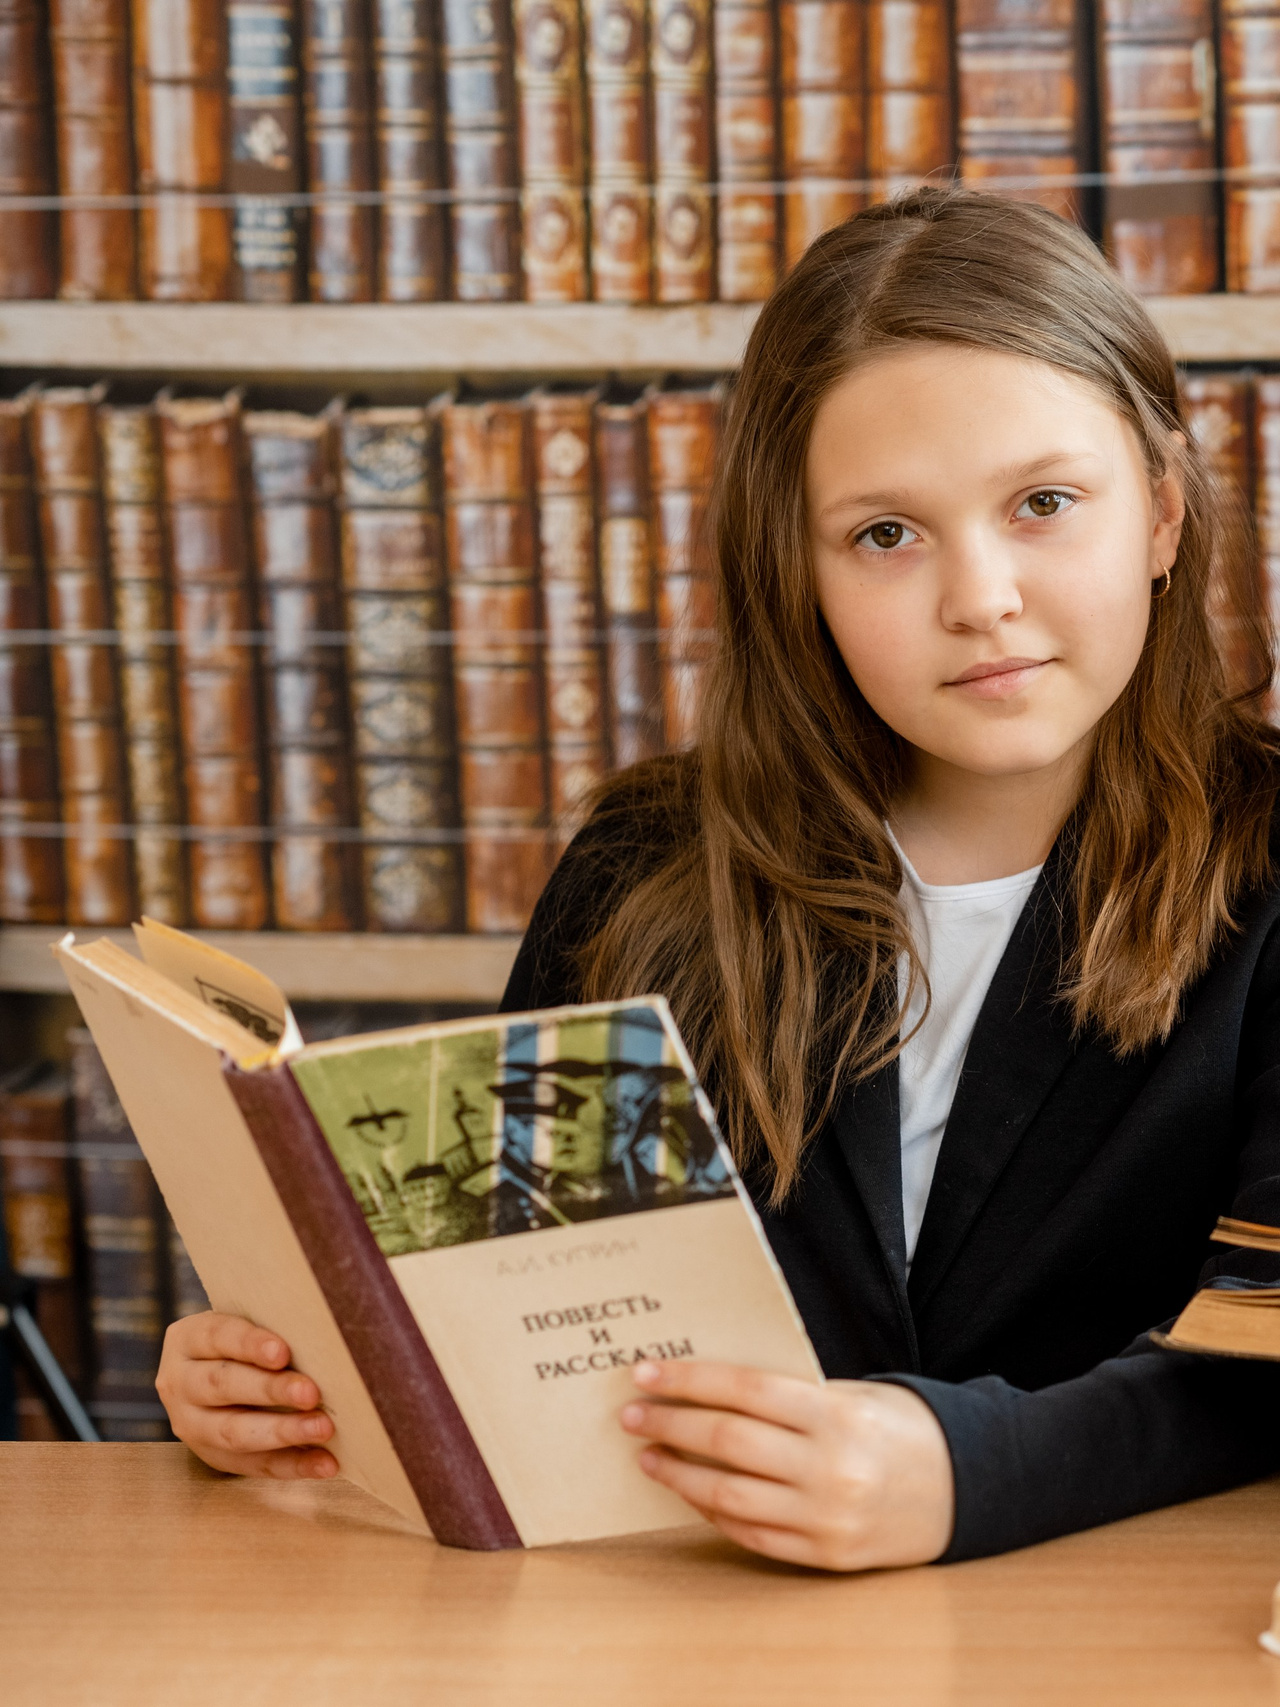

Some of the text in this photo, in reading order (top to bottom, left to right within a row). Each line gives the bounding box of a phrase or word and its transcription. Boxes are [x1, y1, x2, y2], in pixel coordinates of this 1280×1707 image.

[521, 1294, 661, 1334] ПОВЕСТЬ
[589, 1327, 613, 1346] И
[534, 1338, 695, 1381] РАССКАЗЫ
